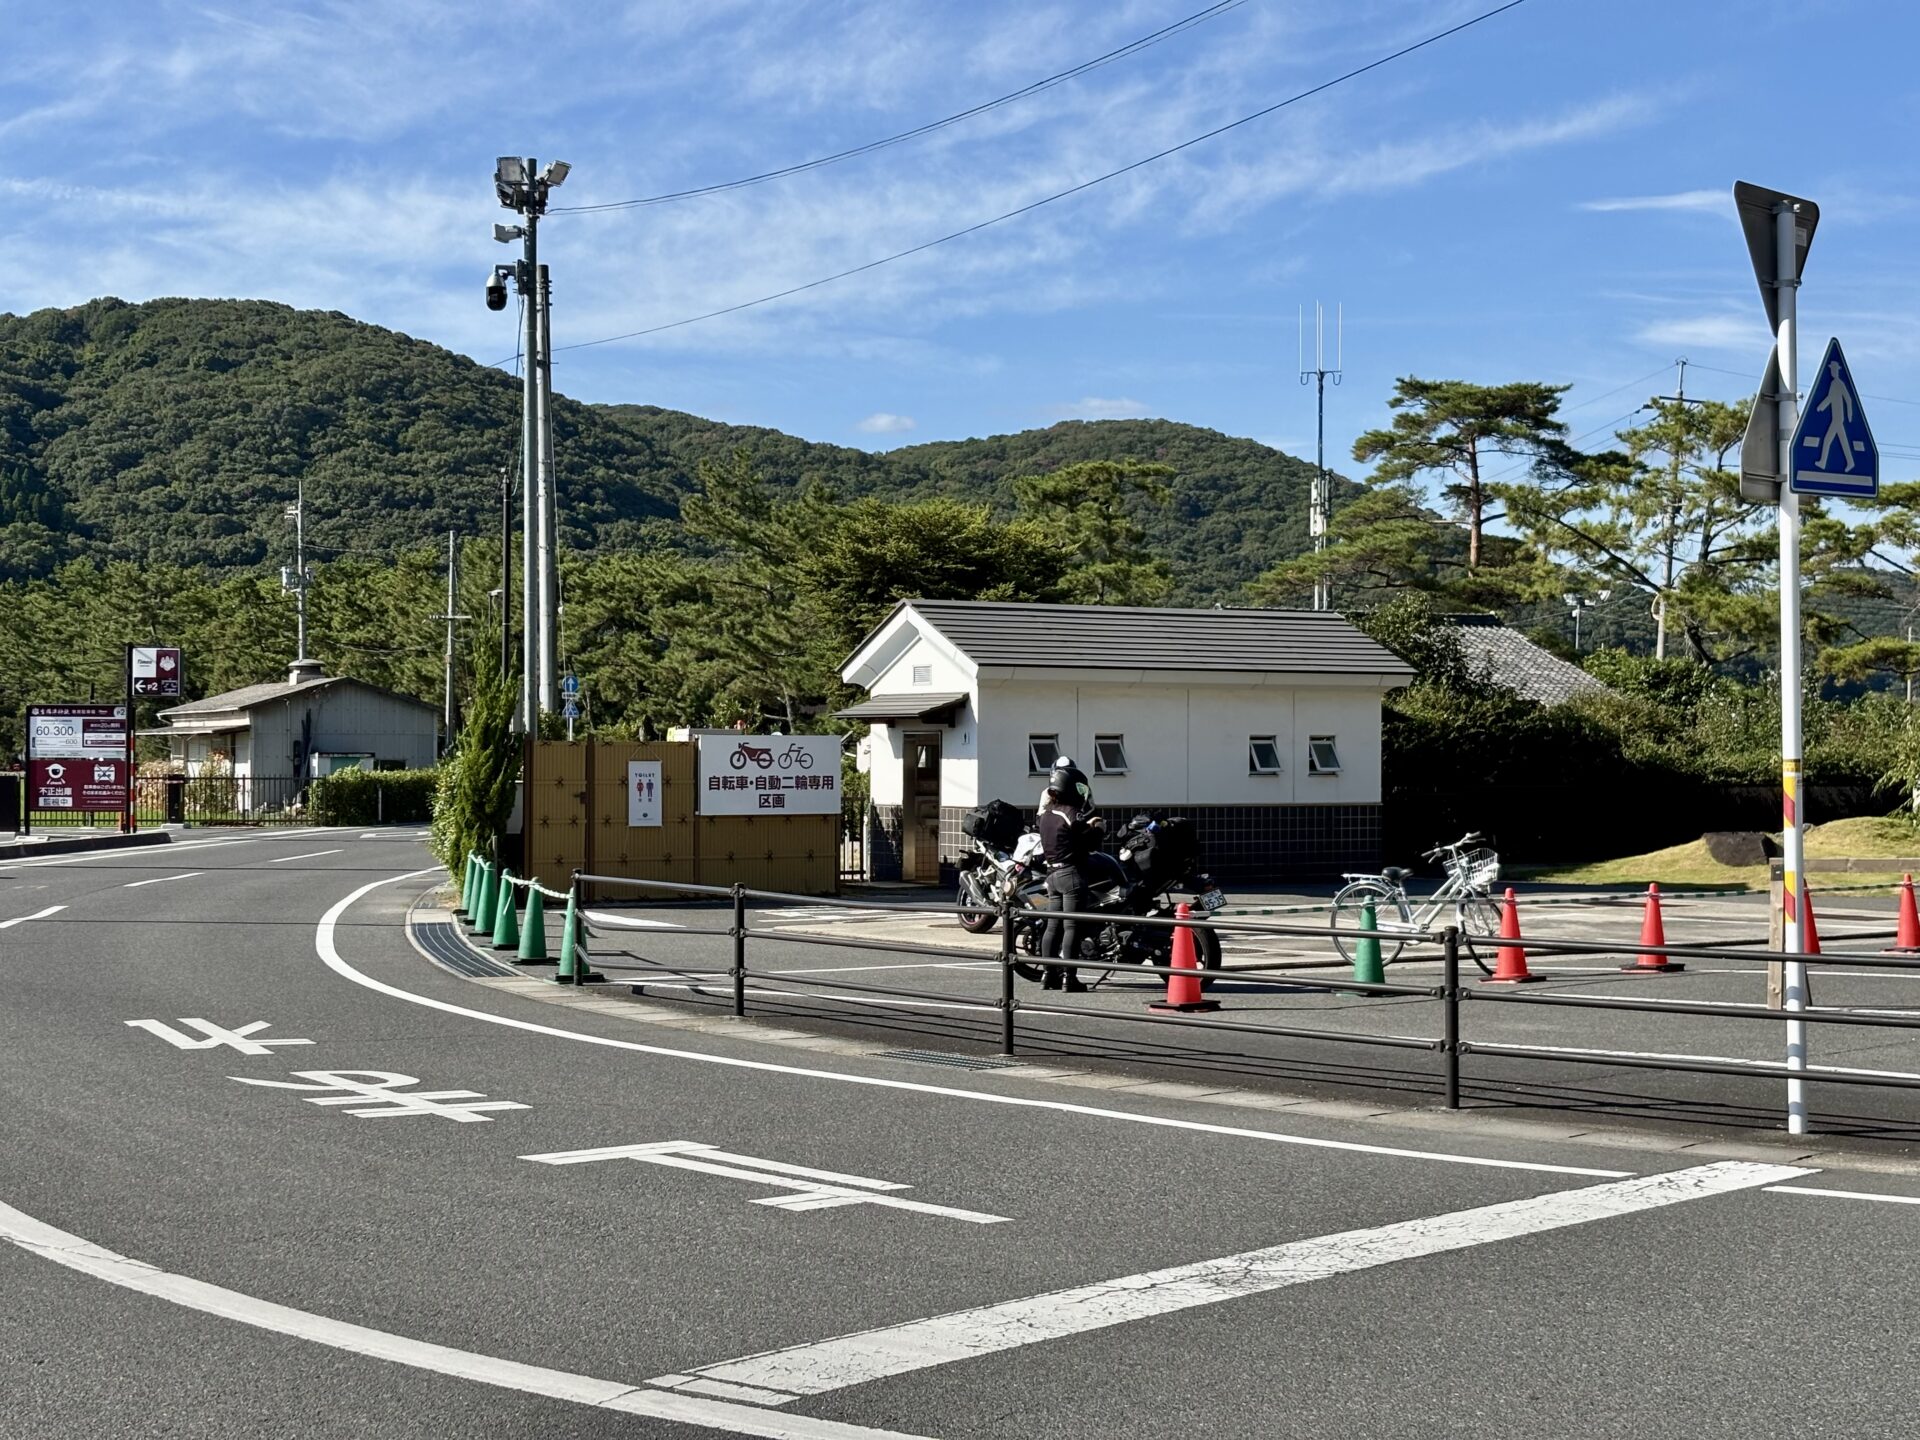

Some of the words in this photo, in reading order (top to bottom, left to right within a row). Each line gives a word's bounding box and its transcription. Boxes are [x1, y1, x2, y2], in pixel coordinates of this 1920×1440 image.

[147, 682, 158, 691] P2
[708, 775, 834, 791] 自転車・自動二輪専用
[39, 787, 73, 796] 不正出庫
[43, 798, 69, 806] 監視中
[758, 794, 785, 809] 区画
[124, 1017, 1013, 1225] 止まれ
